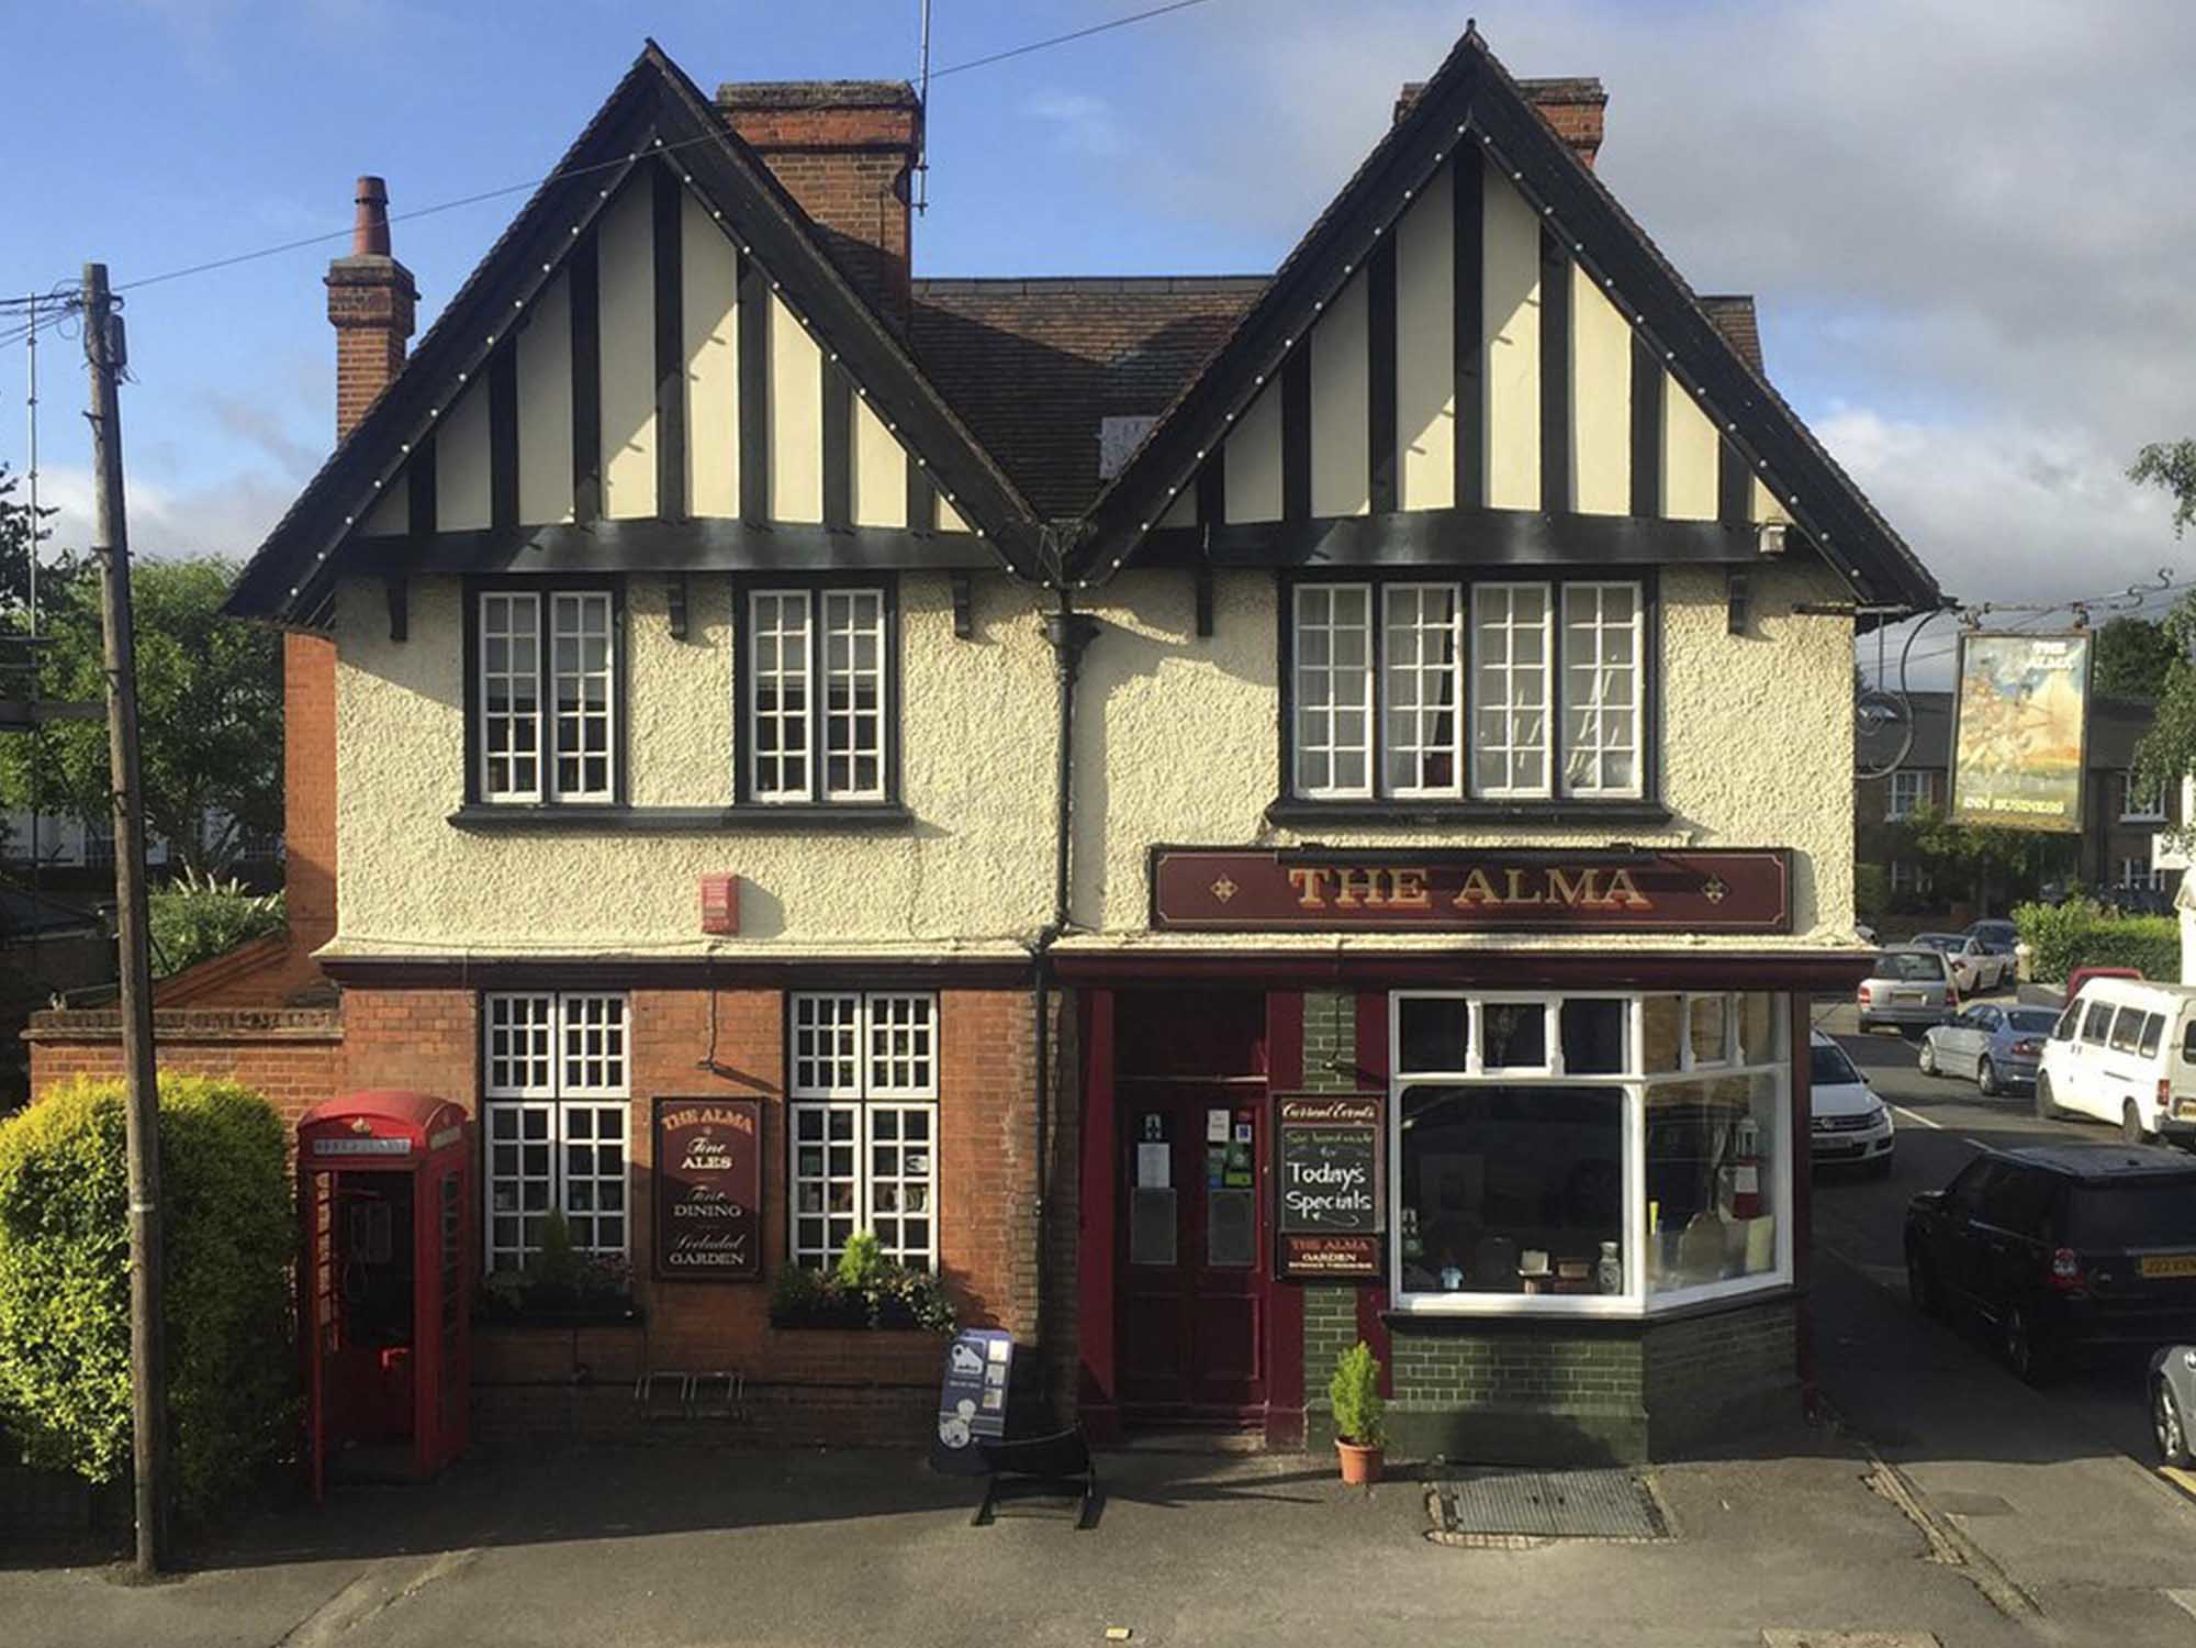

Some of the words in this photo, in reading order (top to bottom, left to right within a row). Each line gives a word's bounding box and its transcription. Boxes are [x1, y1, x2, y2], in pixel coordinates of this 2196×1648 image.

[1288, 868, 1431, 909] THE
[1452, 868, 1652, 909] ALMA
[1333, 1102, 1375, 1118] Events
[662, 1109, 698, 1131] THE
[701, 1108, 753, 1135] ALMA
[688, 1137, 726, 1155] Fine
[681, 1156, 733, 1170] ALES
[1285, 1160, 1366, 1192] Today's
[673, 1205, 742, 1218] DINING
[1285, 1189, 1373, 1219] Specials
[1324, 1239, 1369, 1251] ALMA
[669, 1253, 745, 1266] GARDEN
[1302, 1252, 1357, 1262] GARDEN
